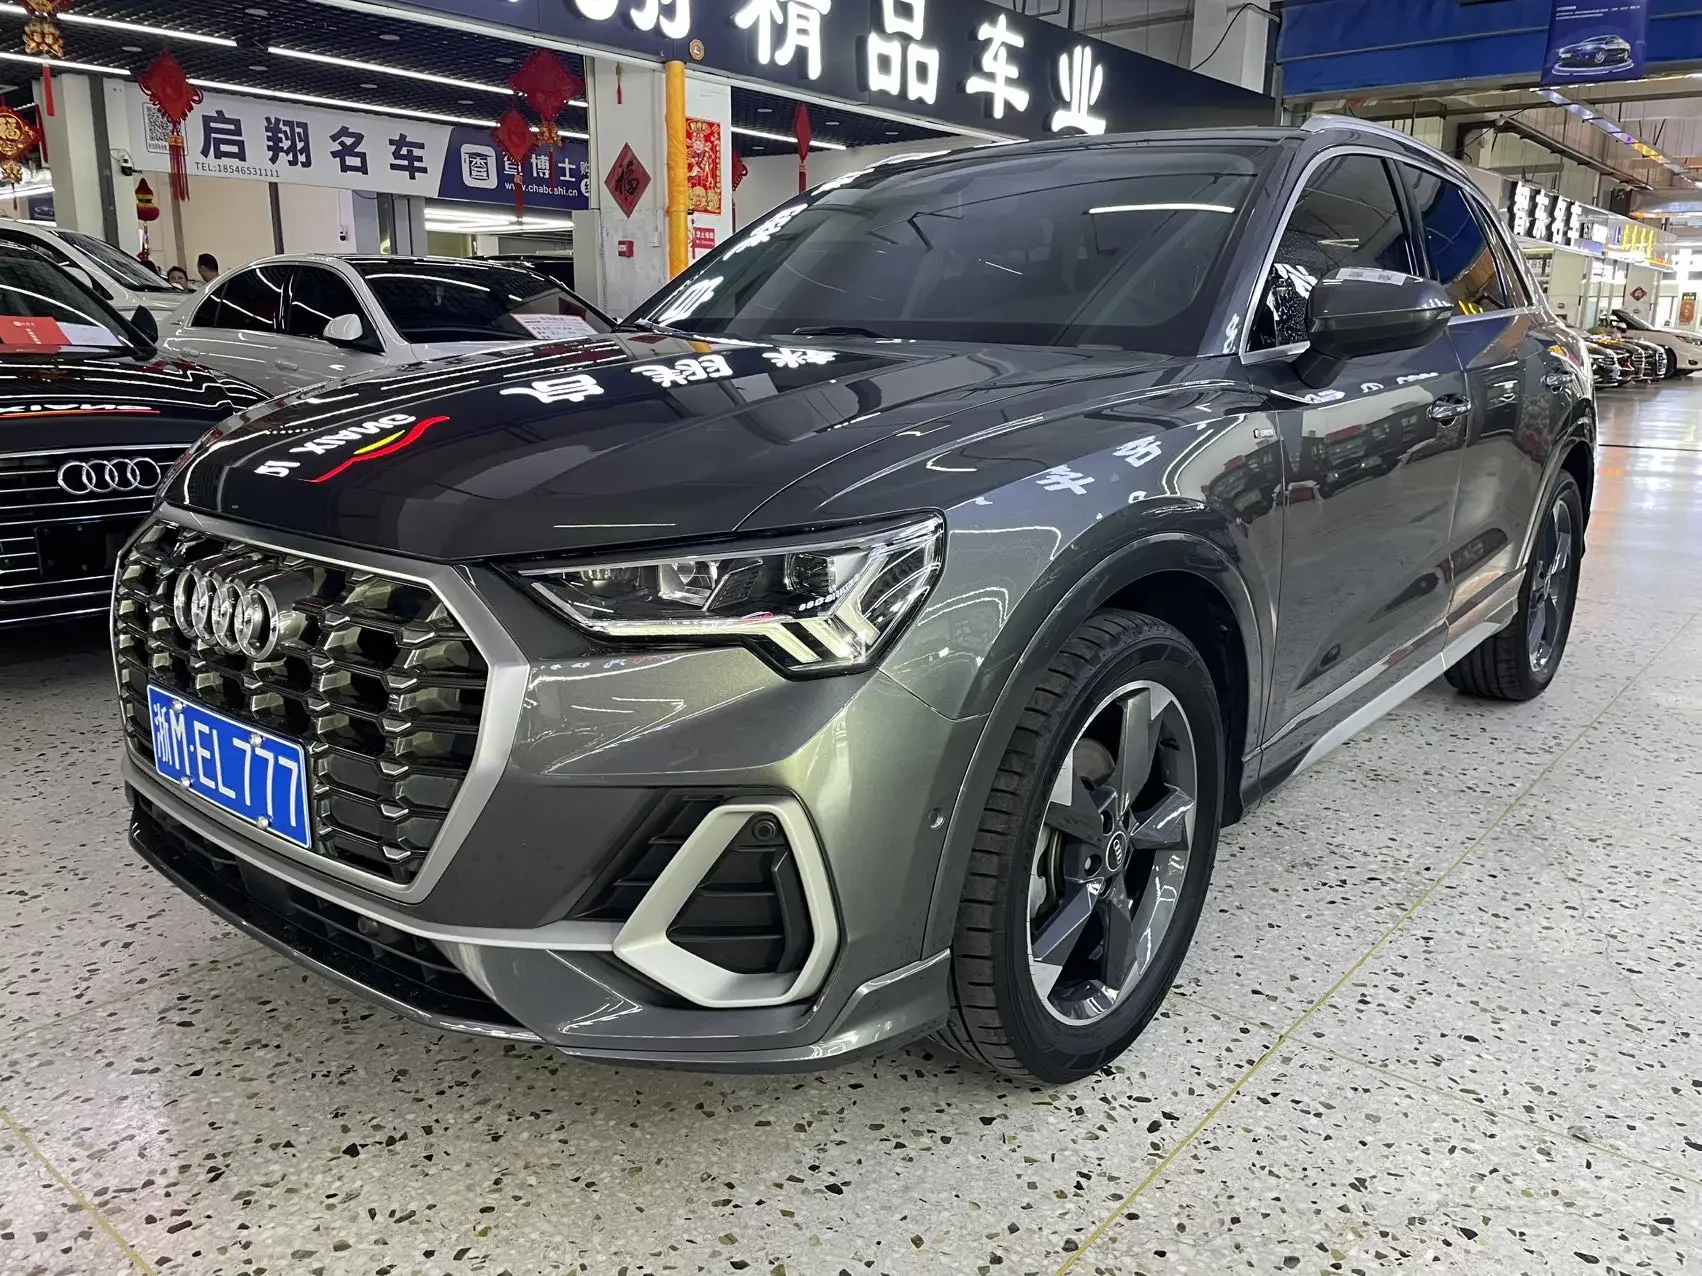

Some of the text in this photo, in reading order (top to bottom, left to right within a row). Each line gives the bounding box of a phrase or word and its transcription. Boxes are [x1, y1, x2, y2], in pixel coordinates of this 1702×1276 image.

[508, 0, 1107, 135] 精品车业
[194, 161, 280, 178] TEL:18546531111
[200, 110, 429, 180] 启翔名车
